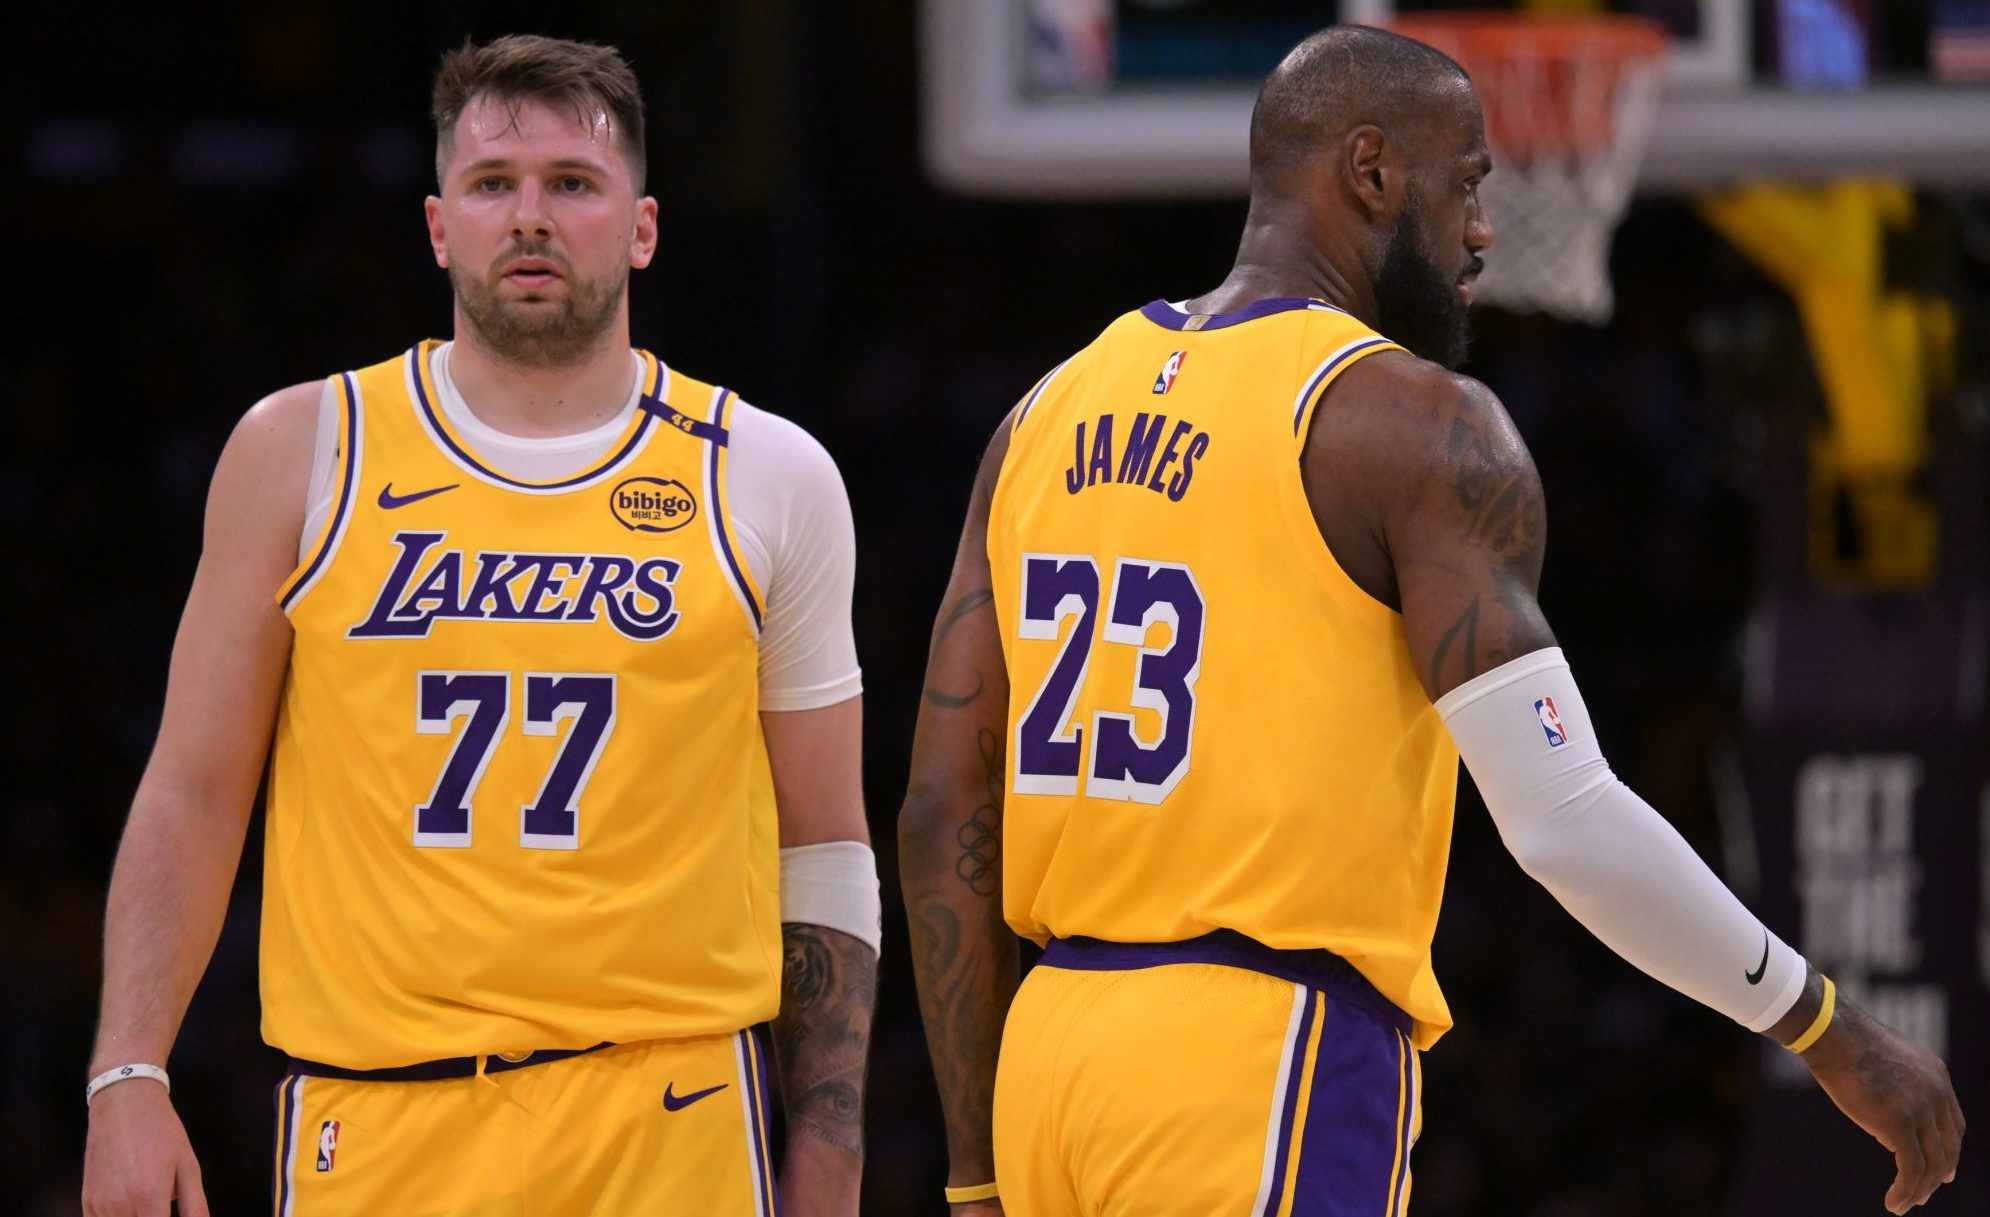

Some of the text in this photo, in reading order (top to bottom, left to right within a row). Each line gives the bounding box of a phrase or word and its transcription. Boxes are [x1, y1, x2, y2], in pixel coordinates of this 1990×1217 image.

[672, 413, 694, 432] 44
[1066, 412, 1209, 502] JAMES
[618, 491, 691, 517] bibigo
[631, 511, 662, 520] 비비고
[345, 530, 683, 642] LAKERS
[1014, 553, 1206, 806] 23
[412, 670, 618, 851] 77
